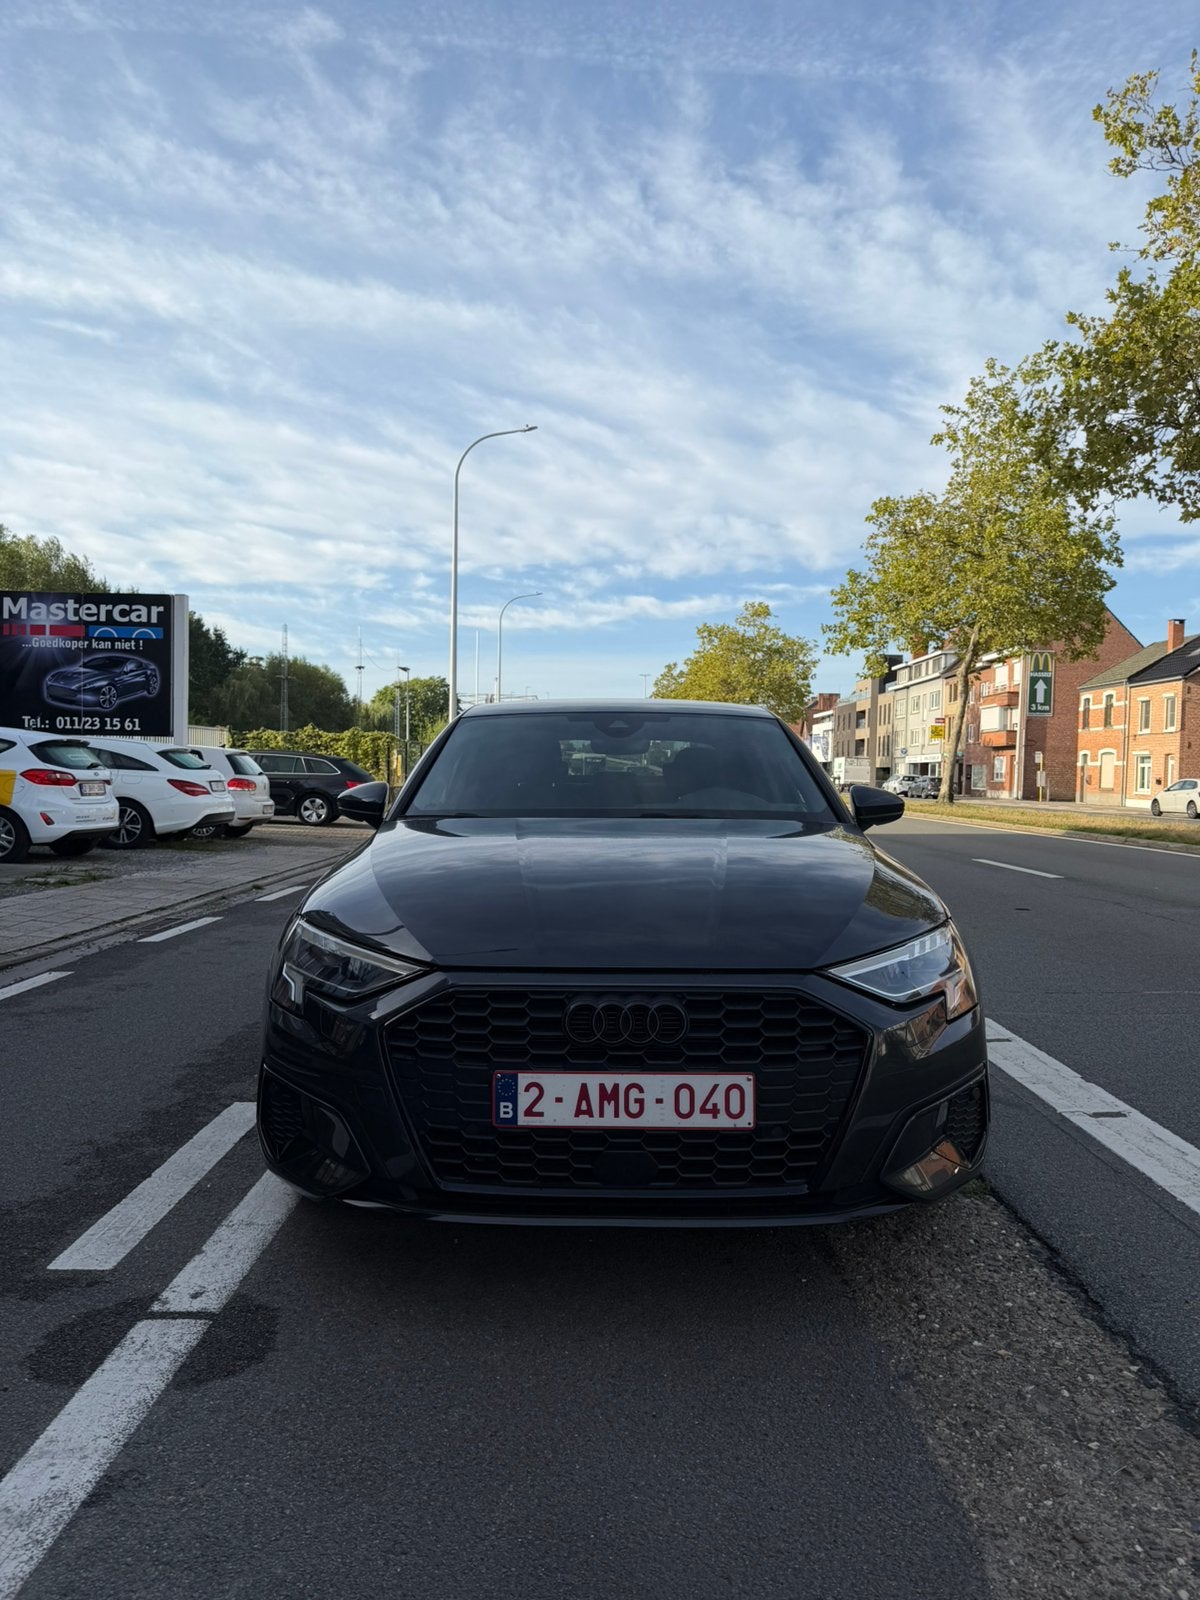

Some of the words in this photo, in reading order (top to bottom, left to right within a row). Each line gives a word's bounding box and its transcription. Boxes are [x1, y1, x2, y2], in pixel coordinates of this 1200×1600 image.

[2, 596, 165, 624] Mastercar
[22, 637, 89, 651] ...Goedkoper
[91, 639, 112, 650] kan
[114, 639, 136, 650] niet
[1030, 703, 1037, 711] 3
[1037, 703, 1050, 711] km
[22, 715, 50, 729] Tel.:
[56, 716, 101, 730] 011/23
[104, 717, 121, 730] 15
[124, 718, 141, 731] 61
[522, 1081, 746, 1120] 2-AMG-040
[500, 1102, 513, 1118] B
